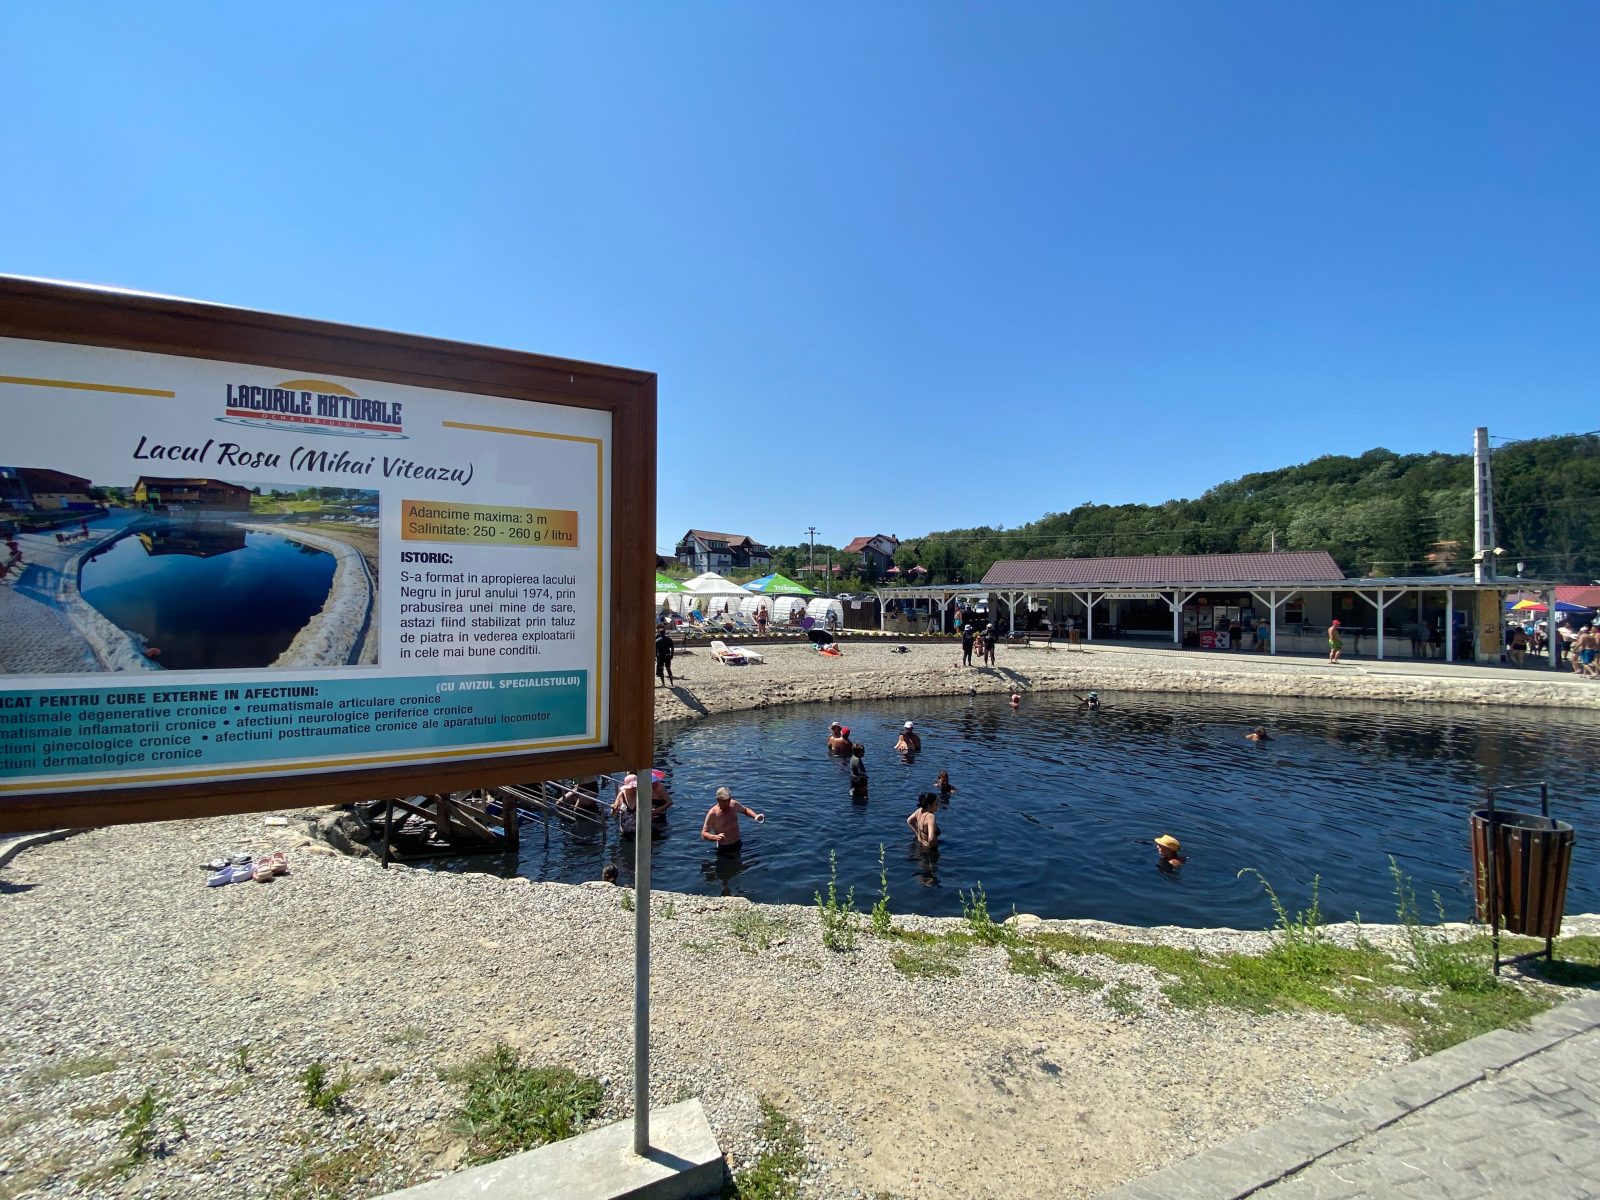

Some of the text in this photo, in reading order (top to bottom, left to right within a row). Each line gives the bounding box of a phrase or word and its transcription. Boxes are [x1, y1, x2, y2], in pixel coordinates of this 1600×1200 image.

[226, 384, 402, 424] LACURILE NATURALE
[132, 436, 474, 486] Lacul Rosu (Mihai Viteazu)
[409, 506, 547, 524] Adancime maxima: 3 m
[409, 522, 469, 536] Salinitate:
[473, 526, 496, 537] 250
[509, 528, 530, 538] 260
[534, 530, 541, 541] g
[544, 529, 548, 539] /
[552, 530, 572, 541] litru
[401, 552, 453, 563] ISTORIC:
[401, 571, 576, 586] S-a format in apropierea lacului
[401, 587, 575, 600] Negru in jurul anului 1974, prin
[401, 602, 576, 614] prabusirea unei mine de sare,
[400, 616, 575, 628] astazi fiind stabilizat prin taluz
[400, 630, 575, 644] de piatra in vederea exploatarii
[400, 645, 541, 658] in cele mai bune conditii.
[436, 676, 580, 693] (CU AVIZUL SPECIALISTULUI)
[40, 694, 100, 708] PENTRU
[107, 693, 146, 705] CURE
[153, 691, 218, 703] EXTERNE
[225, 690, 238, 700] IN
[245, 687, 318, 699] AFECTIUNI:
[79, 707, 171, 722] degenerative
[177, 704, 227, 717] cronice
[248, 699, 333, 712] reumatismale
[339, 697, 395, 708] articulare
[400, 695, 441, 705] cronice
[79, 722, 158, 736] inflamatorii
[166, 720, 216, 732] cronice
[237, 714, 292, 727] afectiuni
[299, 711, 369, 723] neurologice
[374, 706, 428, 722] periferice
[434, 705, 473, 715] cronice
[43, 739, 133, 755] ginecologice
[140, 735, 190, 748] cronice
[216, 729, 272, 742] afectiuni
[278, 724, 370, 740] posttraumatice
[376, 721, 417, 732] cronice
[422, 719, 438, 729] ale
[444, 715, 497, 728] aparatului
[501, 712, 551, 723] locomotor
[43, 753, 145, 768] dermatologice
[152, 748, 202, 761] cronice
